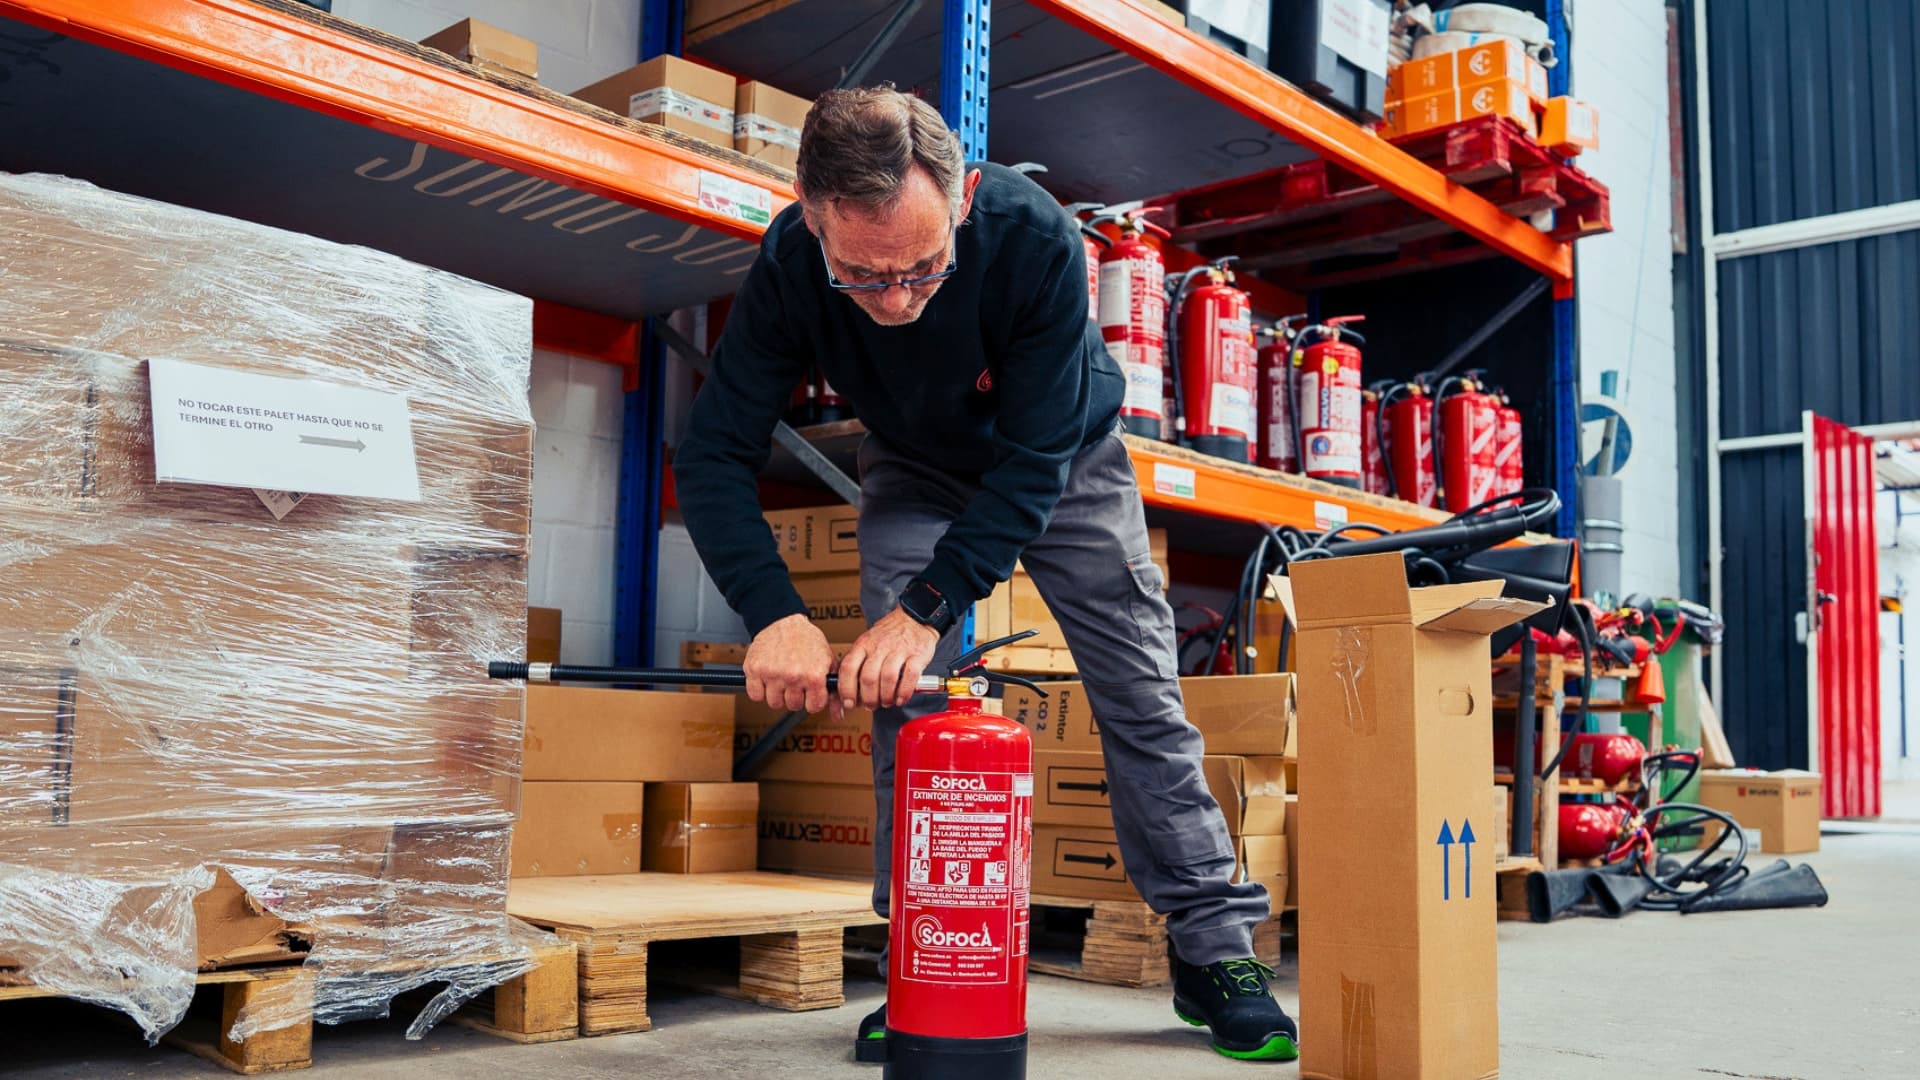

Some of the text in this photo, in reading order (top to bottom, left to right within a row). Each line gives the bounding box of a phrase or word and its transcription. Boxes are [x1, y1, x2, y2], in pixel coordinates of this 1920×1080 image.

[178, 397, 384, 432] NO TOCAR ESTE PALET HASTA QUE NO SE
[180, 412, 274, 432] TERMINE EL OTRO
[804, 516, 814, 560] Extintor
[1036, 701, 1048, 731] CO 2
[1056, 690, 1070, 742] Extintor
[913, 791, 1007, 802] EXTINTOR DE INCENDIOS
[922, 860, 1006, 872] A B C
